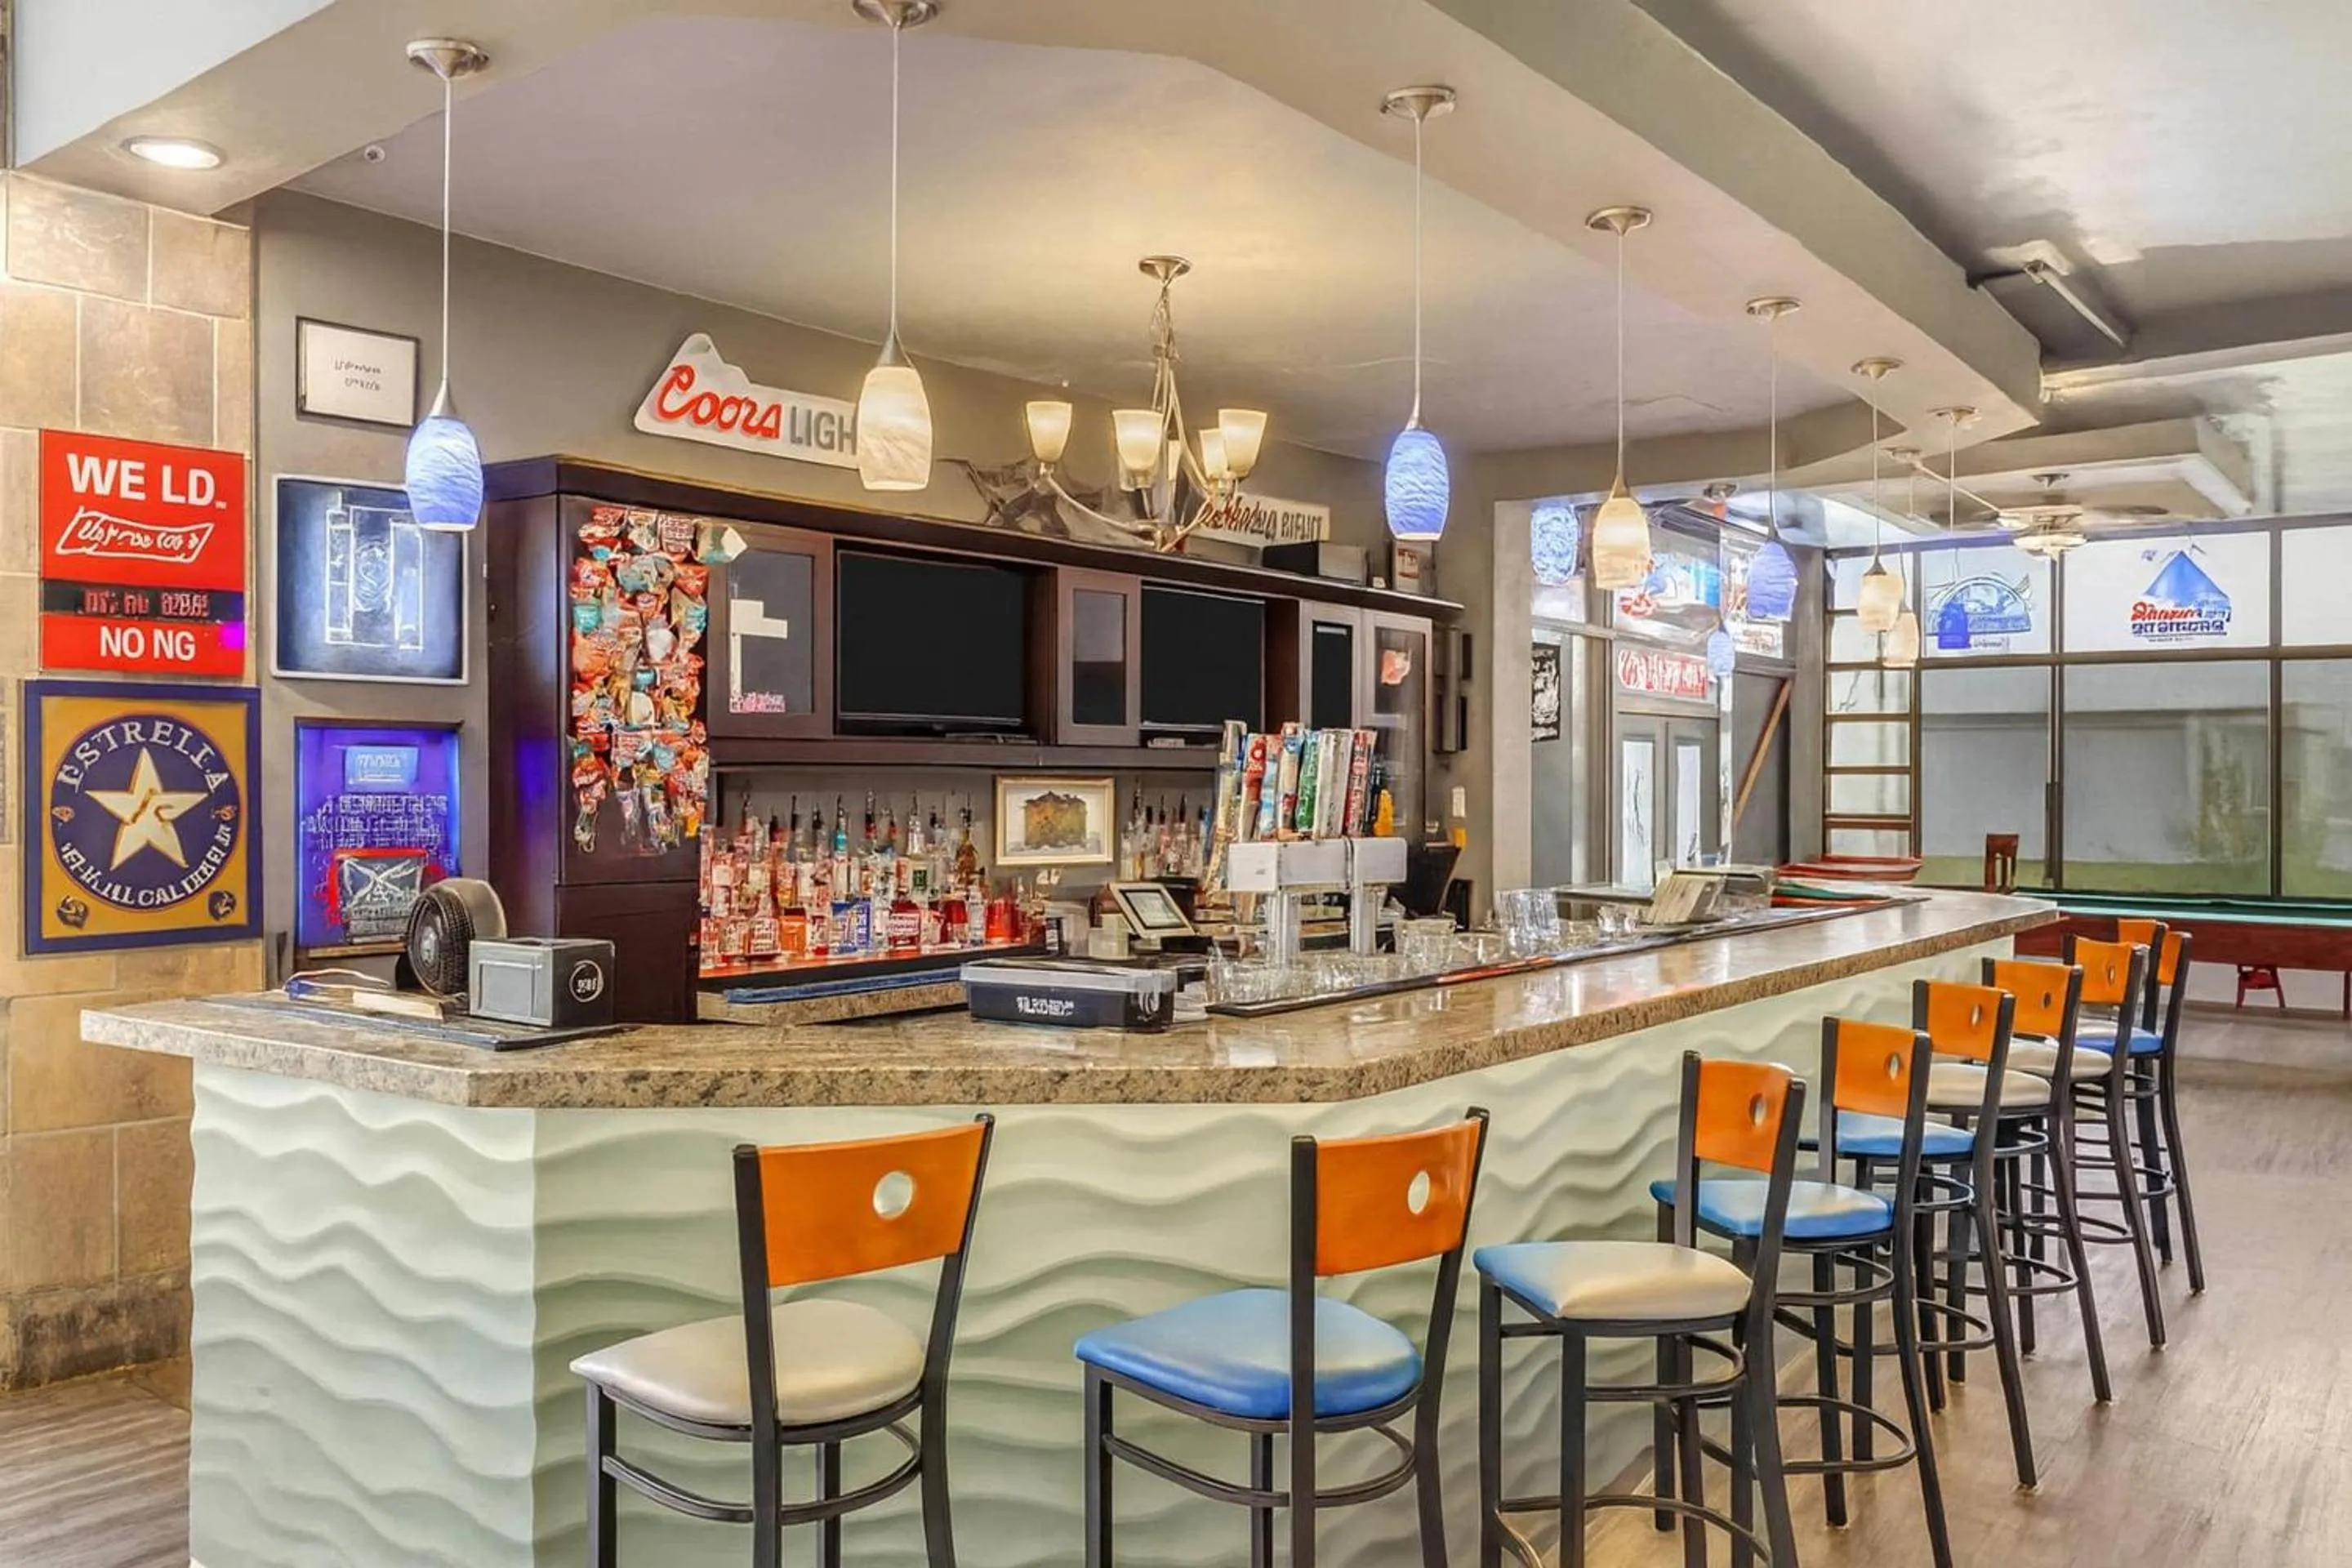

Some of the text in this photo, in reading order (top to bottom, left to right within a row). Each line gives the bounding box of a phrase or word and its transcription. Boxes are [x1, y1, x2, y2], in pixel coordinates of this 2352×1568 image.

[790, 405, 858, 457] LIGH
[66, 452, 146, 501] WE
[100, 625, 196, 662] NO NG
